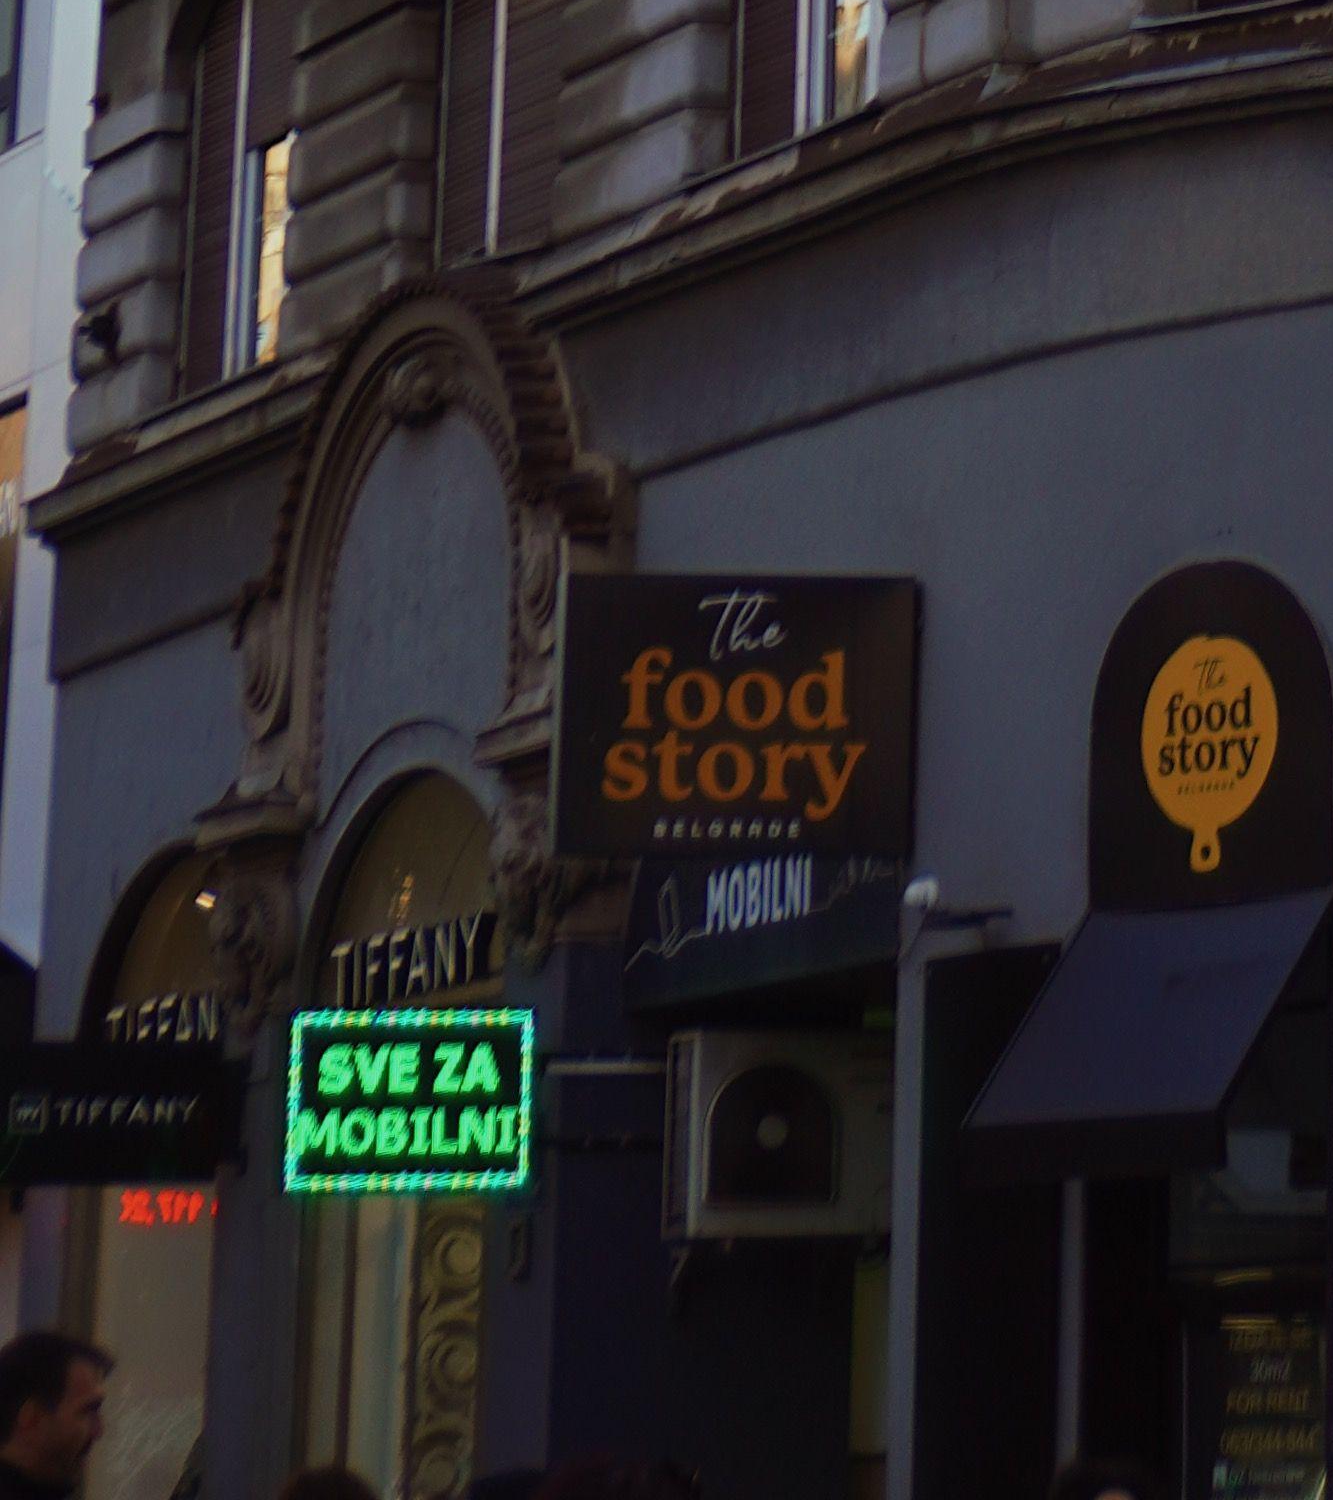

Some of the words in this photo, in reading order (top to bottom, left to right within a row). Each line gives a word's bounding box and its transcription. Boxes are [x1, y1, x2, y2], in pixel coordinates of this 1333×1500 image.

[700, 588, 788, 661] The
[621, 645, 849, 731] food
[1165, 685, 1251, 737] food
[602, 730, 867, 822] story
[1158, 736, 1259, 779] story
[652, 817, 801, 839] BELGRADE
[705, 852, 813, 935] MOBILNI
[331, 908, 484, 1007] TIFFANY
[105, 991, 220, 1043] TIFFAN
[317, 1041, 422, 1097] SVE
[432, 1041, 500, 1095] ZA
[54, 1093, 200, 1126] TIFFANY
[300, 1104, 520, 1157] MOBILNI
